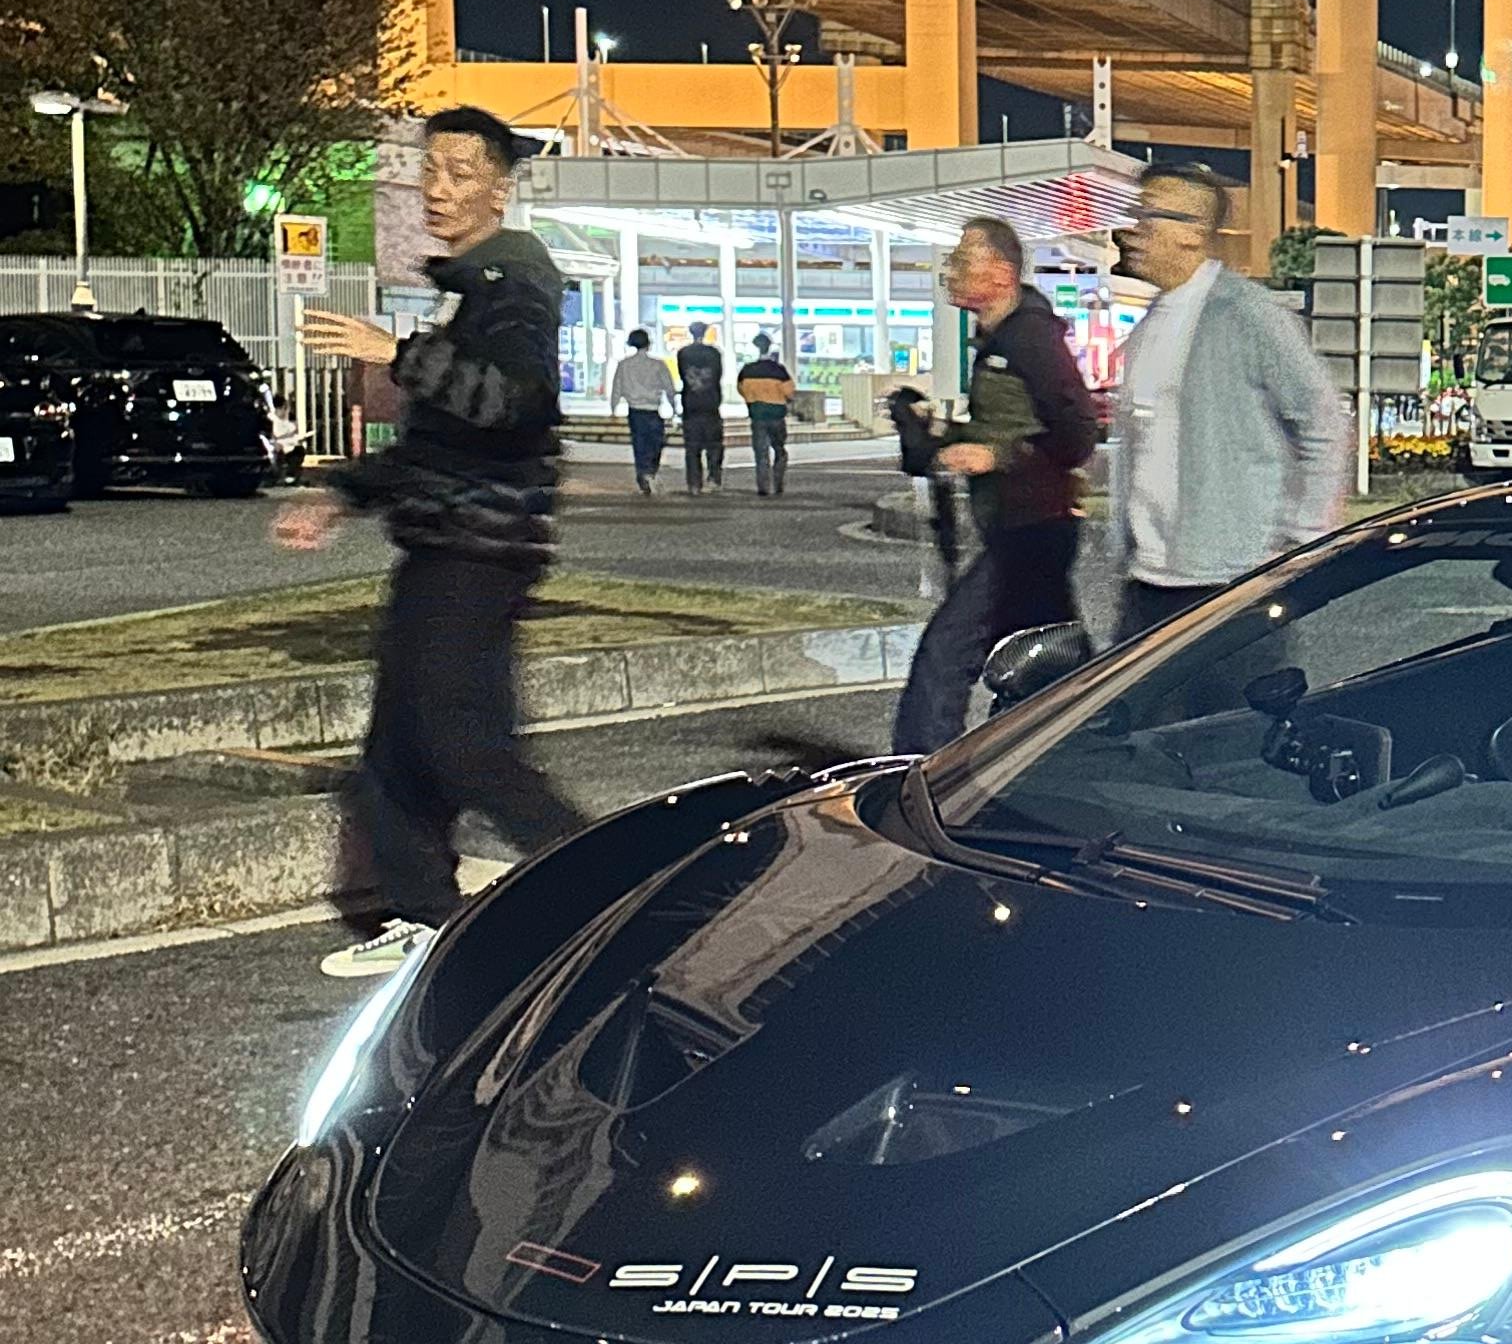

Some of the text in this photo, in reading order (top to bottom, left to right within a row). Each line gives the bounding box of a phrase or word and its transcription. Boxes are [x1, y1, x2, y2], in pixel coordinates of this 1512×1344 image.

[652, 1300, 900, 1320] JAPAN TOUR 2025
